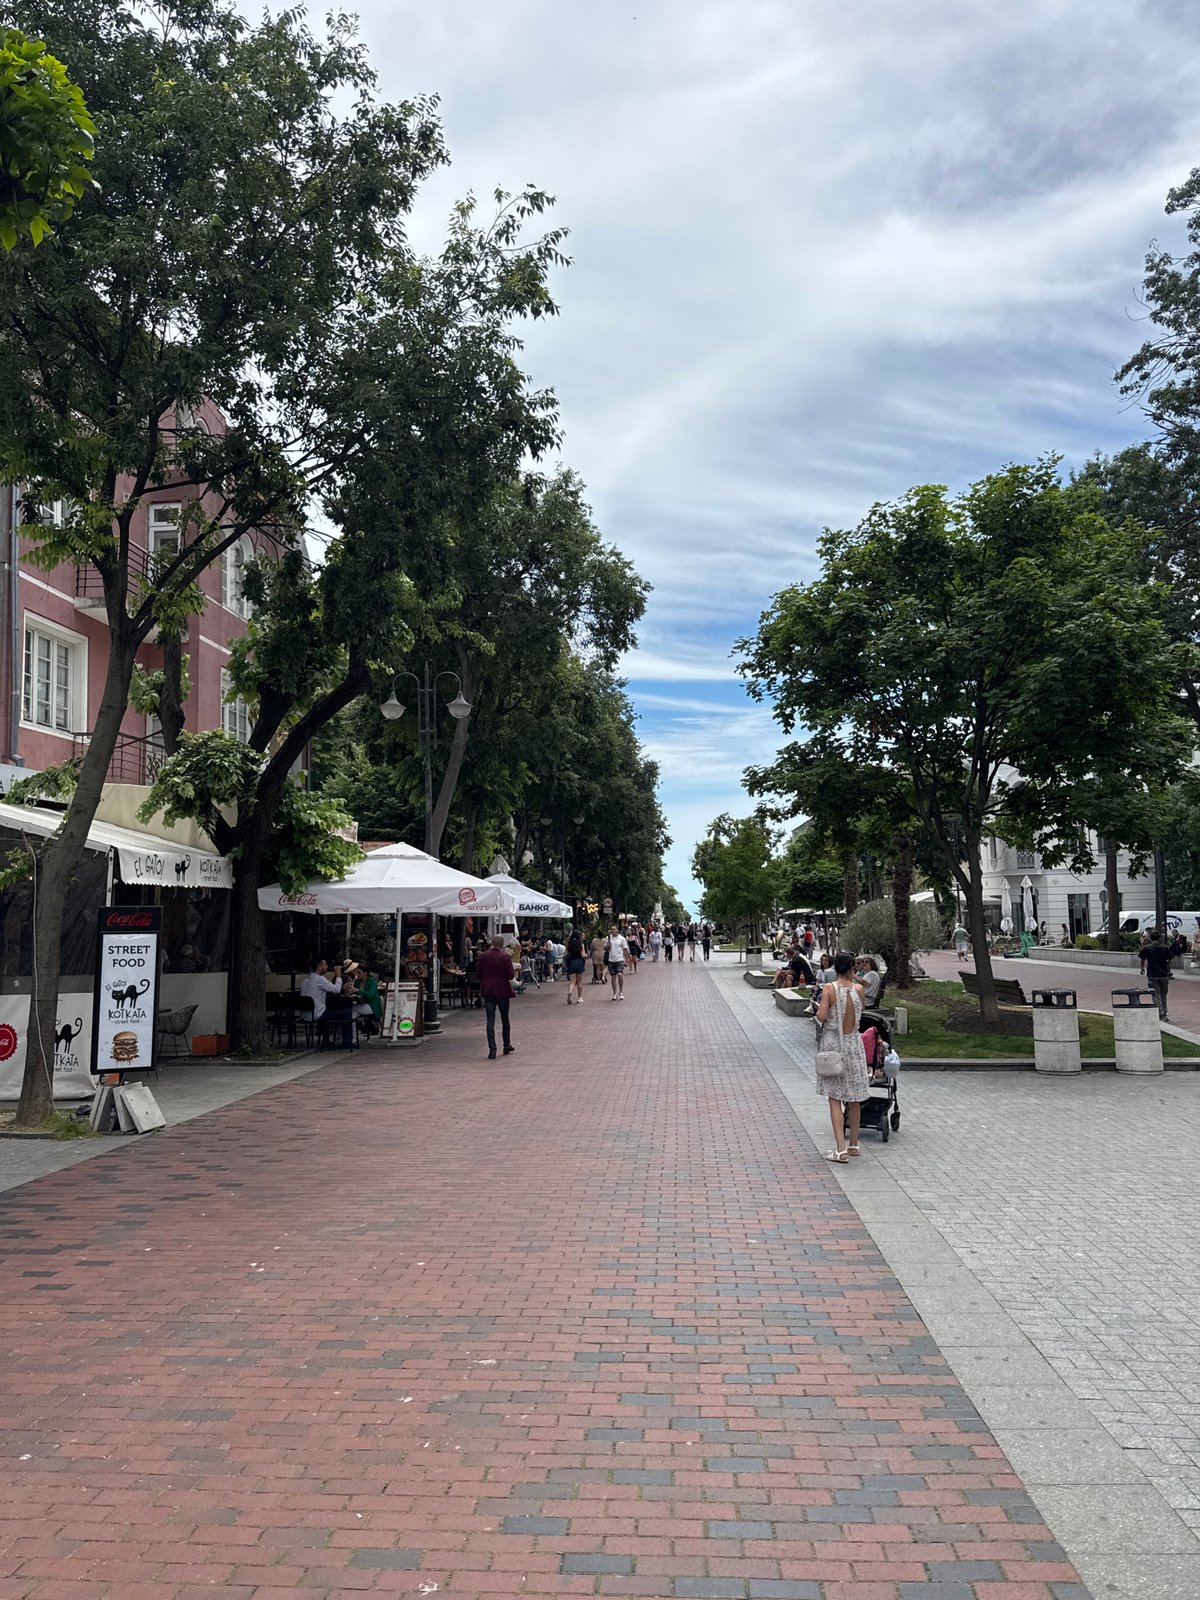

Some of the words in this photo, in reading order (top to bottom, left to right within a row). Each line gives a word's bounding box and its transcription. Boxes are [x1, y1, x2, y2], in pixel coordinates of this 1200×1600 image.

[145, 854, 165, 880] GATO!
[278, 893, 318, 906] Coca-Cola
[518, 903, 549, 912] БАНКЯ
[106, 912, 152, 927] Coca-Cola
[107, 945, 151, 955] STREET
[112, 958, 146, 968] FOOD
[54, 1053, 79, 1067] ТКАТА
